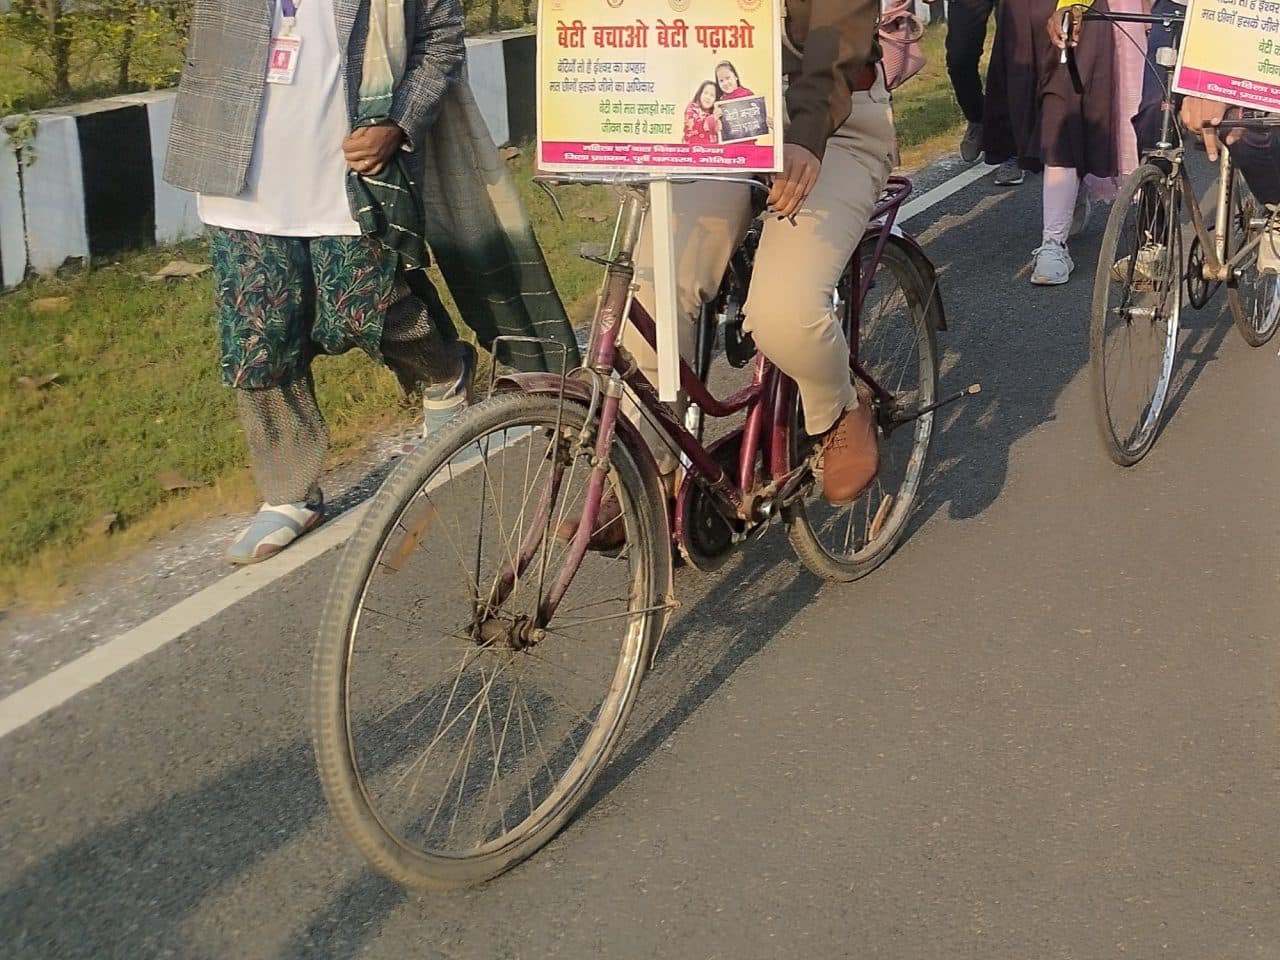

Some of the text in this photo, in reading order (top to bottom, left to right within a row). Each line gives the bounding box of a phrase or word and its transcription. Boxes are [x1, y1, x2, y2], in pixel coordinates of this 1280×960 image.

[1202, 9, 1216, 20] मत
[1237, 15, 1260, 28] इसके
[1261, 17, 1280, 33] जीने
[557, 19, 755, 53] बेटी बचाओ बेटी पढ़ाओ
[1258, 39, 1273, 54] बेटी
